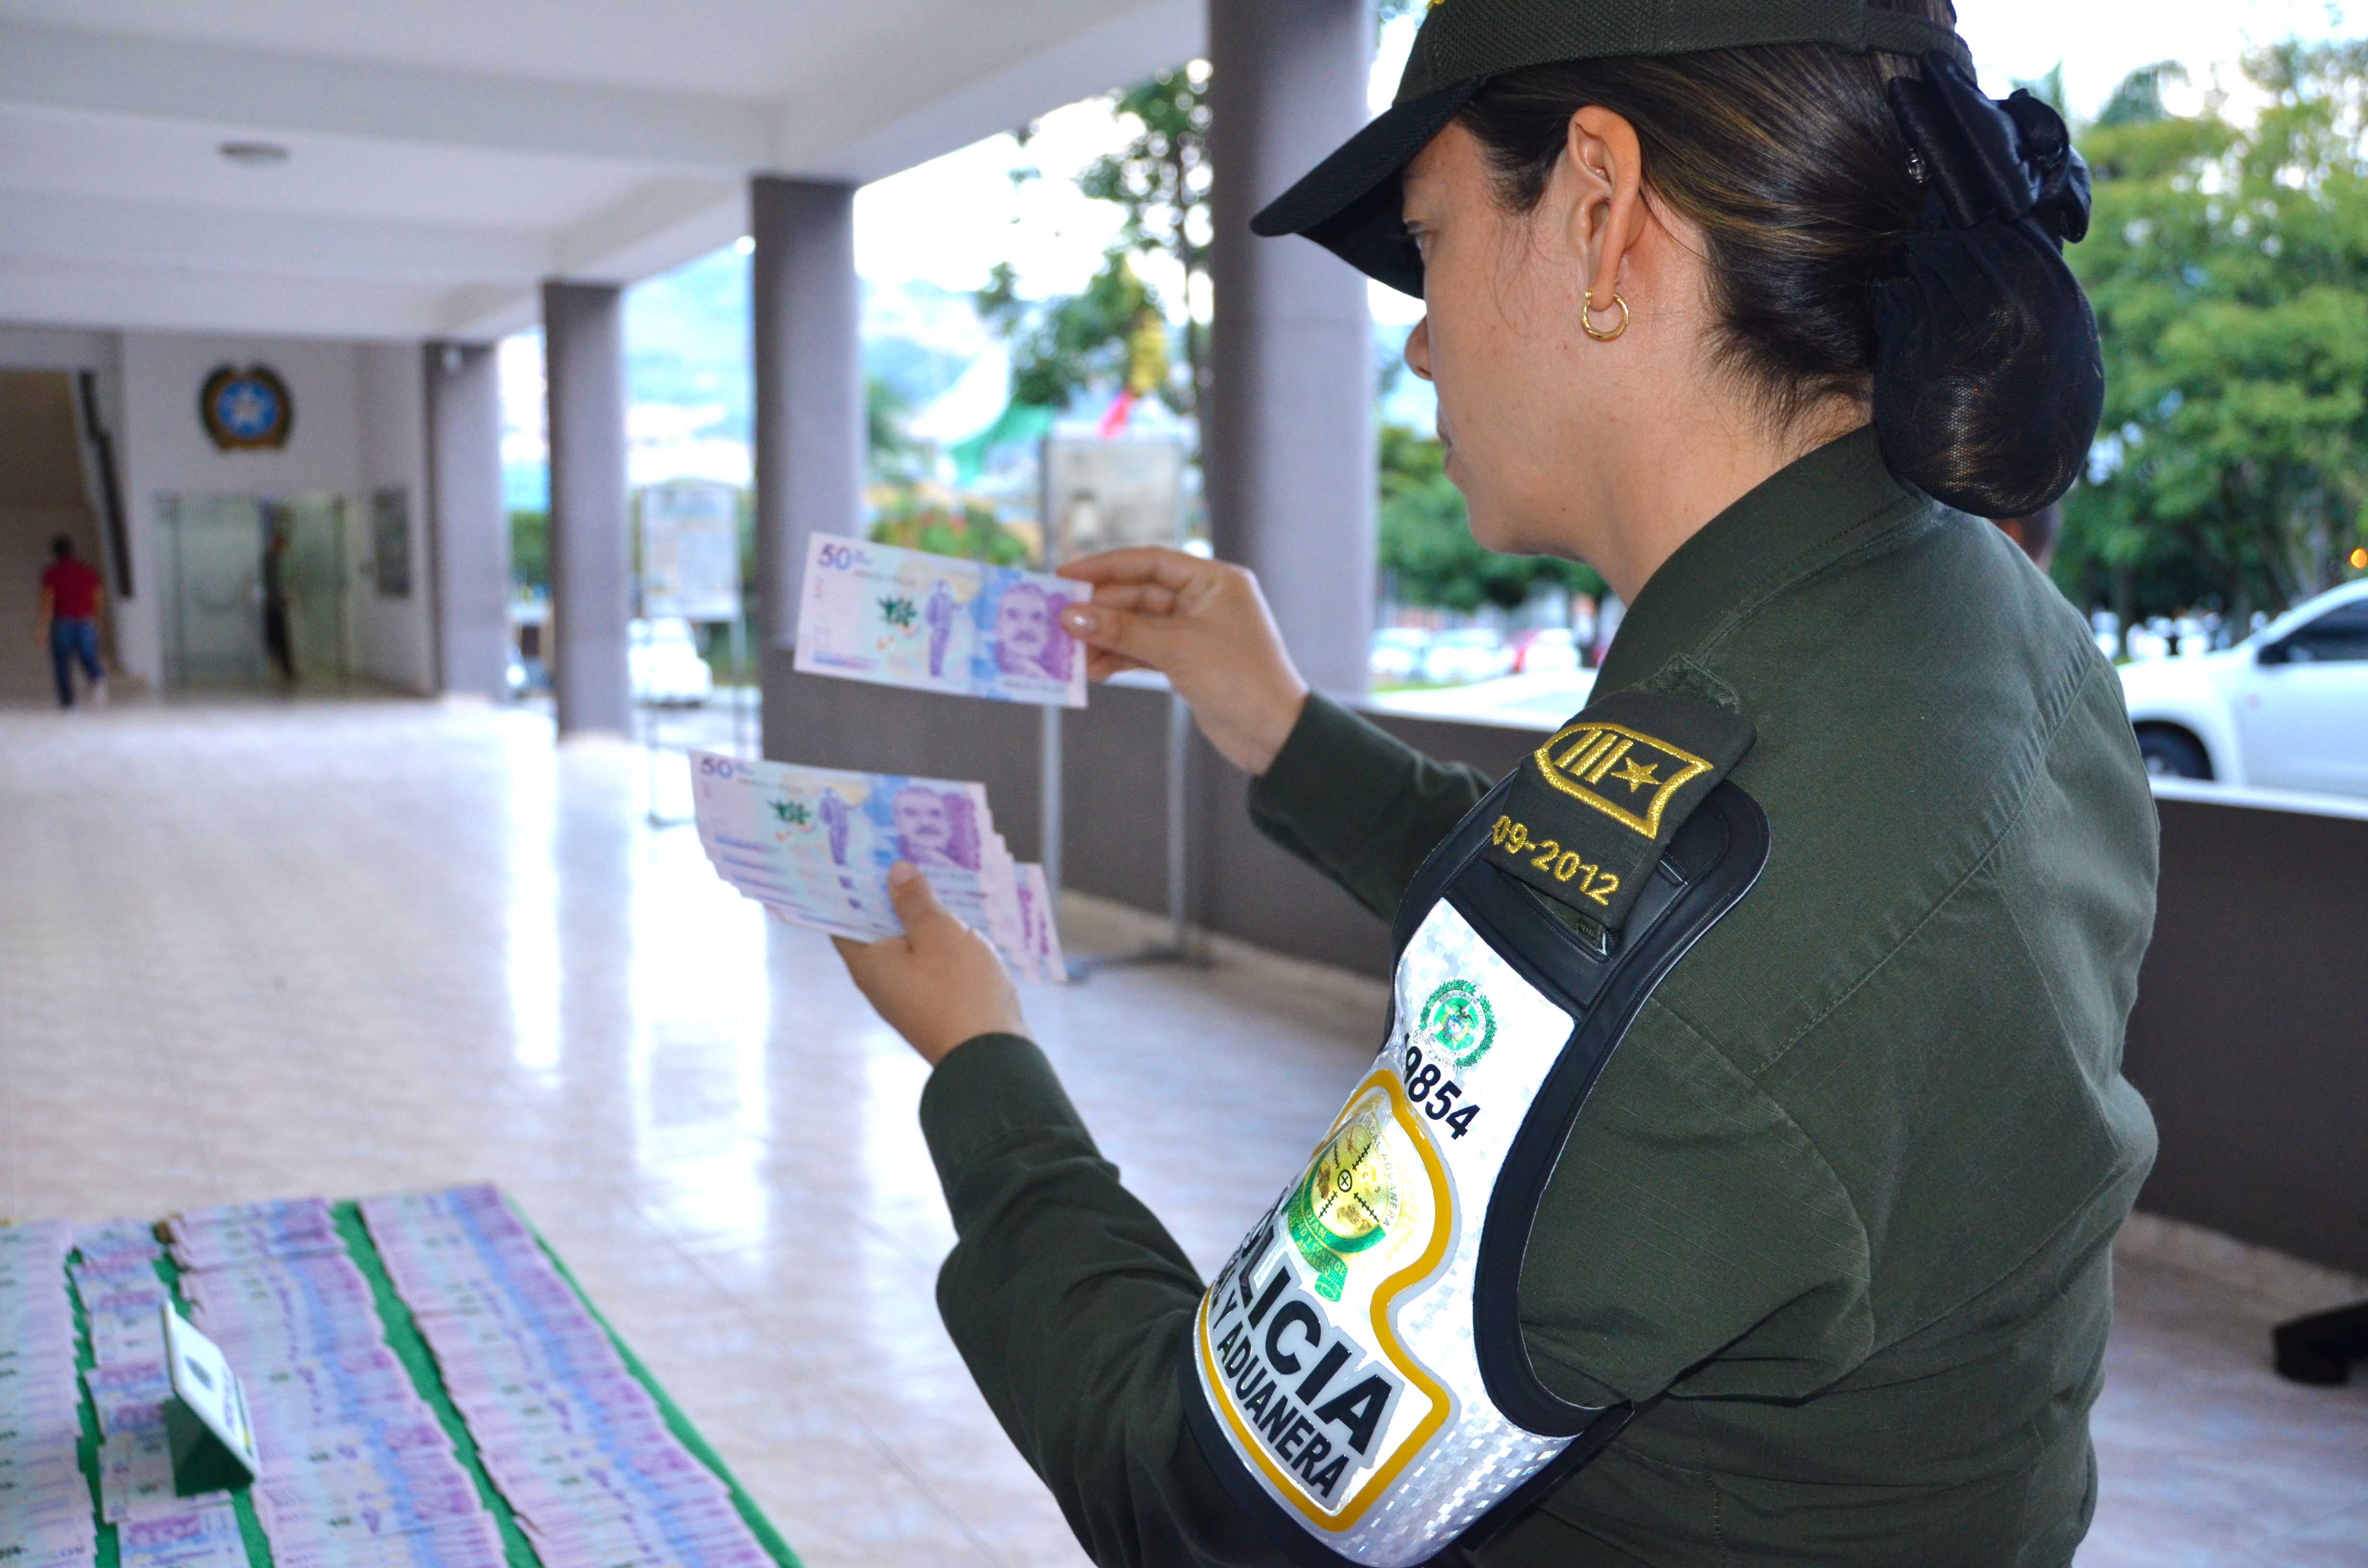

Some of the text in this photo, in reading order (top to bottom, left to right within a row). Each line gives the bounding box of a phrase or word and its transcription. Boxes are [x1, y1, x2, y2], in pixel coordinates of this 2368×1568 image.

[817, 543, 852, 571] 50
[700, 757, 734, 779] 50
[1492, 815, 1620, 906] 09-2012
[1404, 1033, 1480, 1140] 9854
[1433, 1055, 1456, 1069] PATRIA
[1381, 1153, 1398, 1226] ADUANERA
[1213, 1288, 1350, 1498] Y ADUANERA
